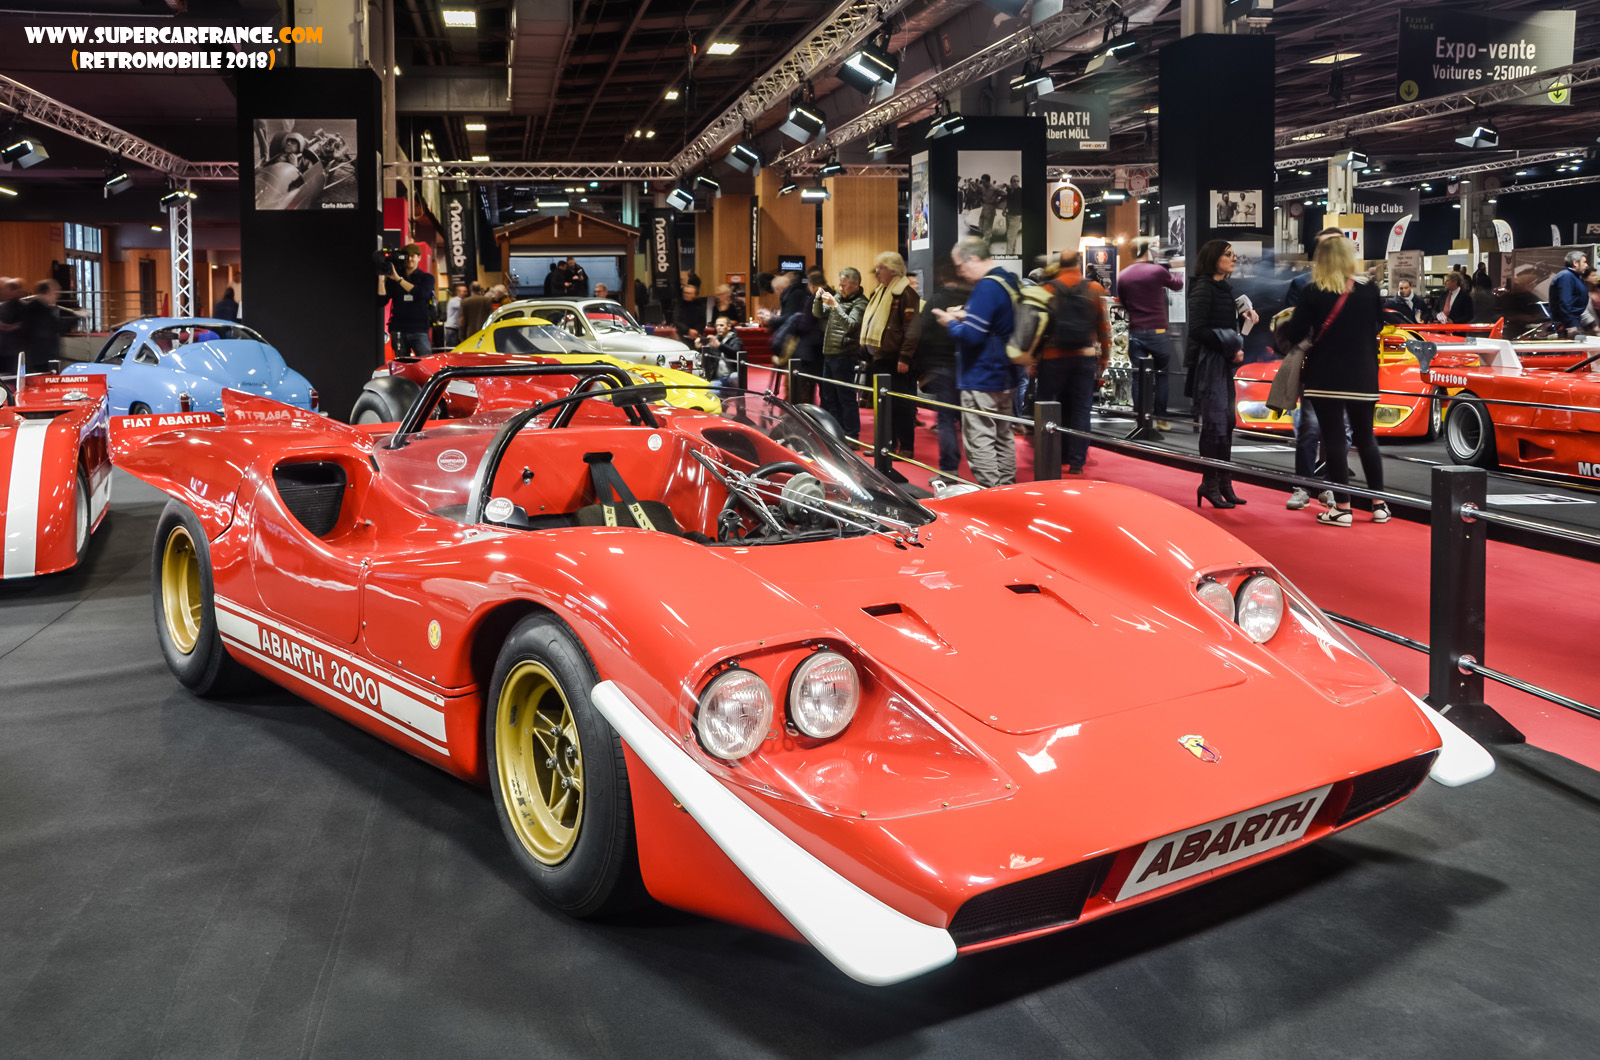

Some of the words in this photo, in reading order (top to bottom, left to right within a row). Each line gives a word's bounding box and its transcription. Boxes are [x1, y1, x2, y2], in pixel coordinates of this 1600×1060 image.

[1436, 37, 1536, 63] Expo-vente
[1432, 64, 1482, 80] Voitures
[1046, 128, 1067, 139] lbert
[1068, 127, 1090, 139] MÖLL
[1381, 203, 1404, 213] Clubs
[45, 376, 60, 384] FIAT
[1429, 370, 1468, 386] Firestone
[122, 417, 152, 429] FIAT
[158, 414, 211, 427] ABARTH
[262, 628, 326, 681] ABARTH
[330, 660, 379, 706] 2000
[1135, 796, 1318, 884] ABARTH
